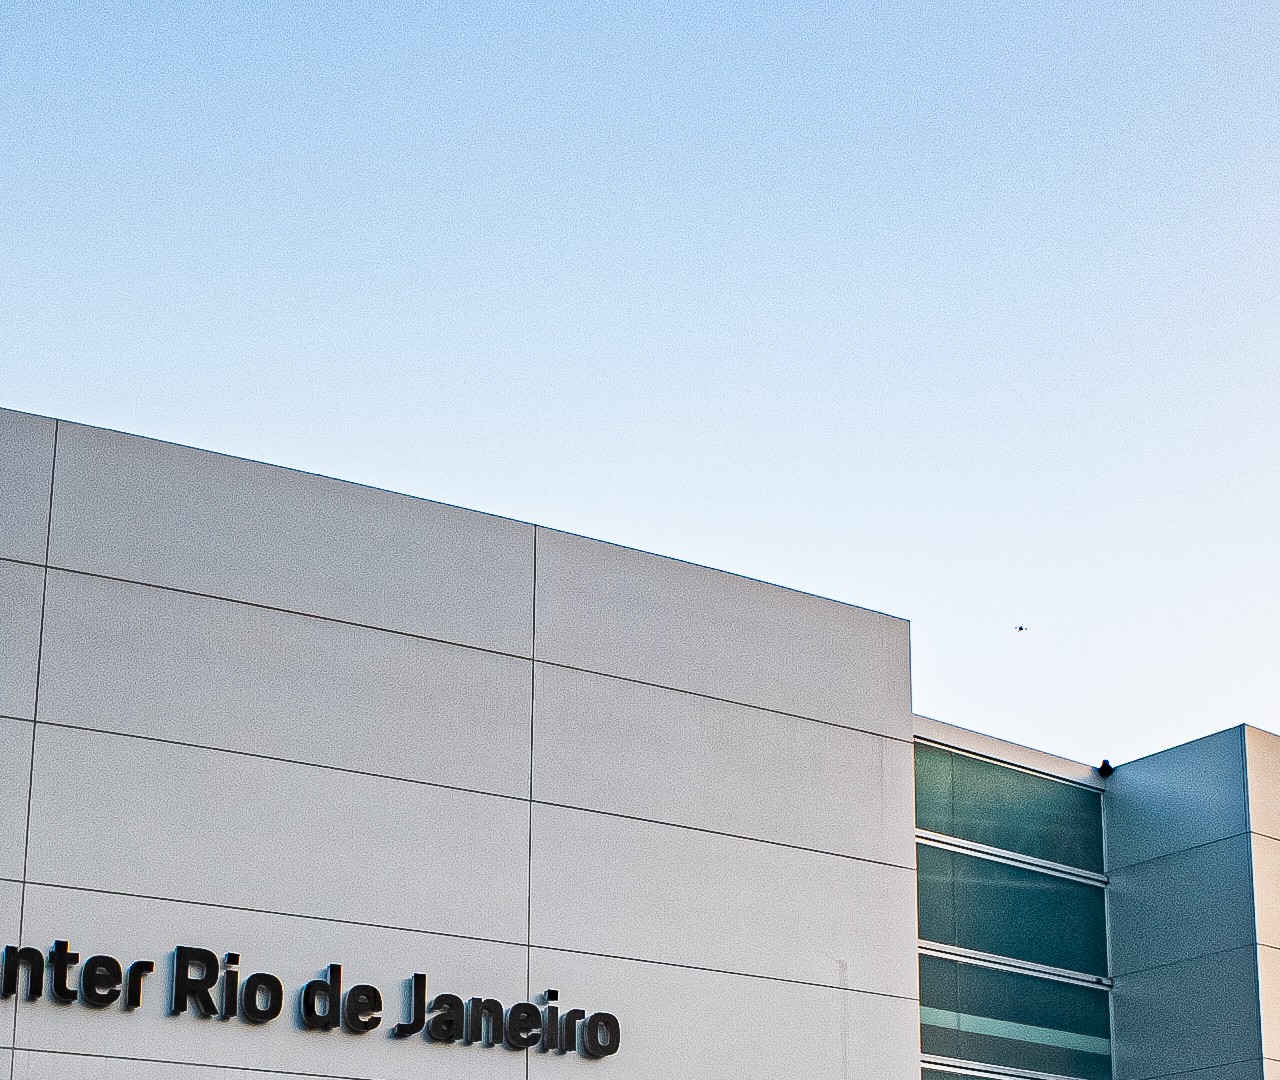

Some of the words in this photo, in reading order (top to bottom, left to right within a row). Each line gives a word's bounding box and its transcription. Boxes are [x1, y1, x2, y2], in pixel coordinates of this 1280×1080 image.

[171, 945, 284, 1024] Rio
[299, 963, 383, 1032] de
[392, 972, 622, 1059] Janeiro
